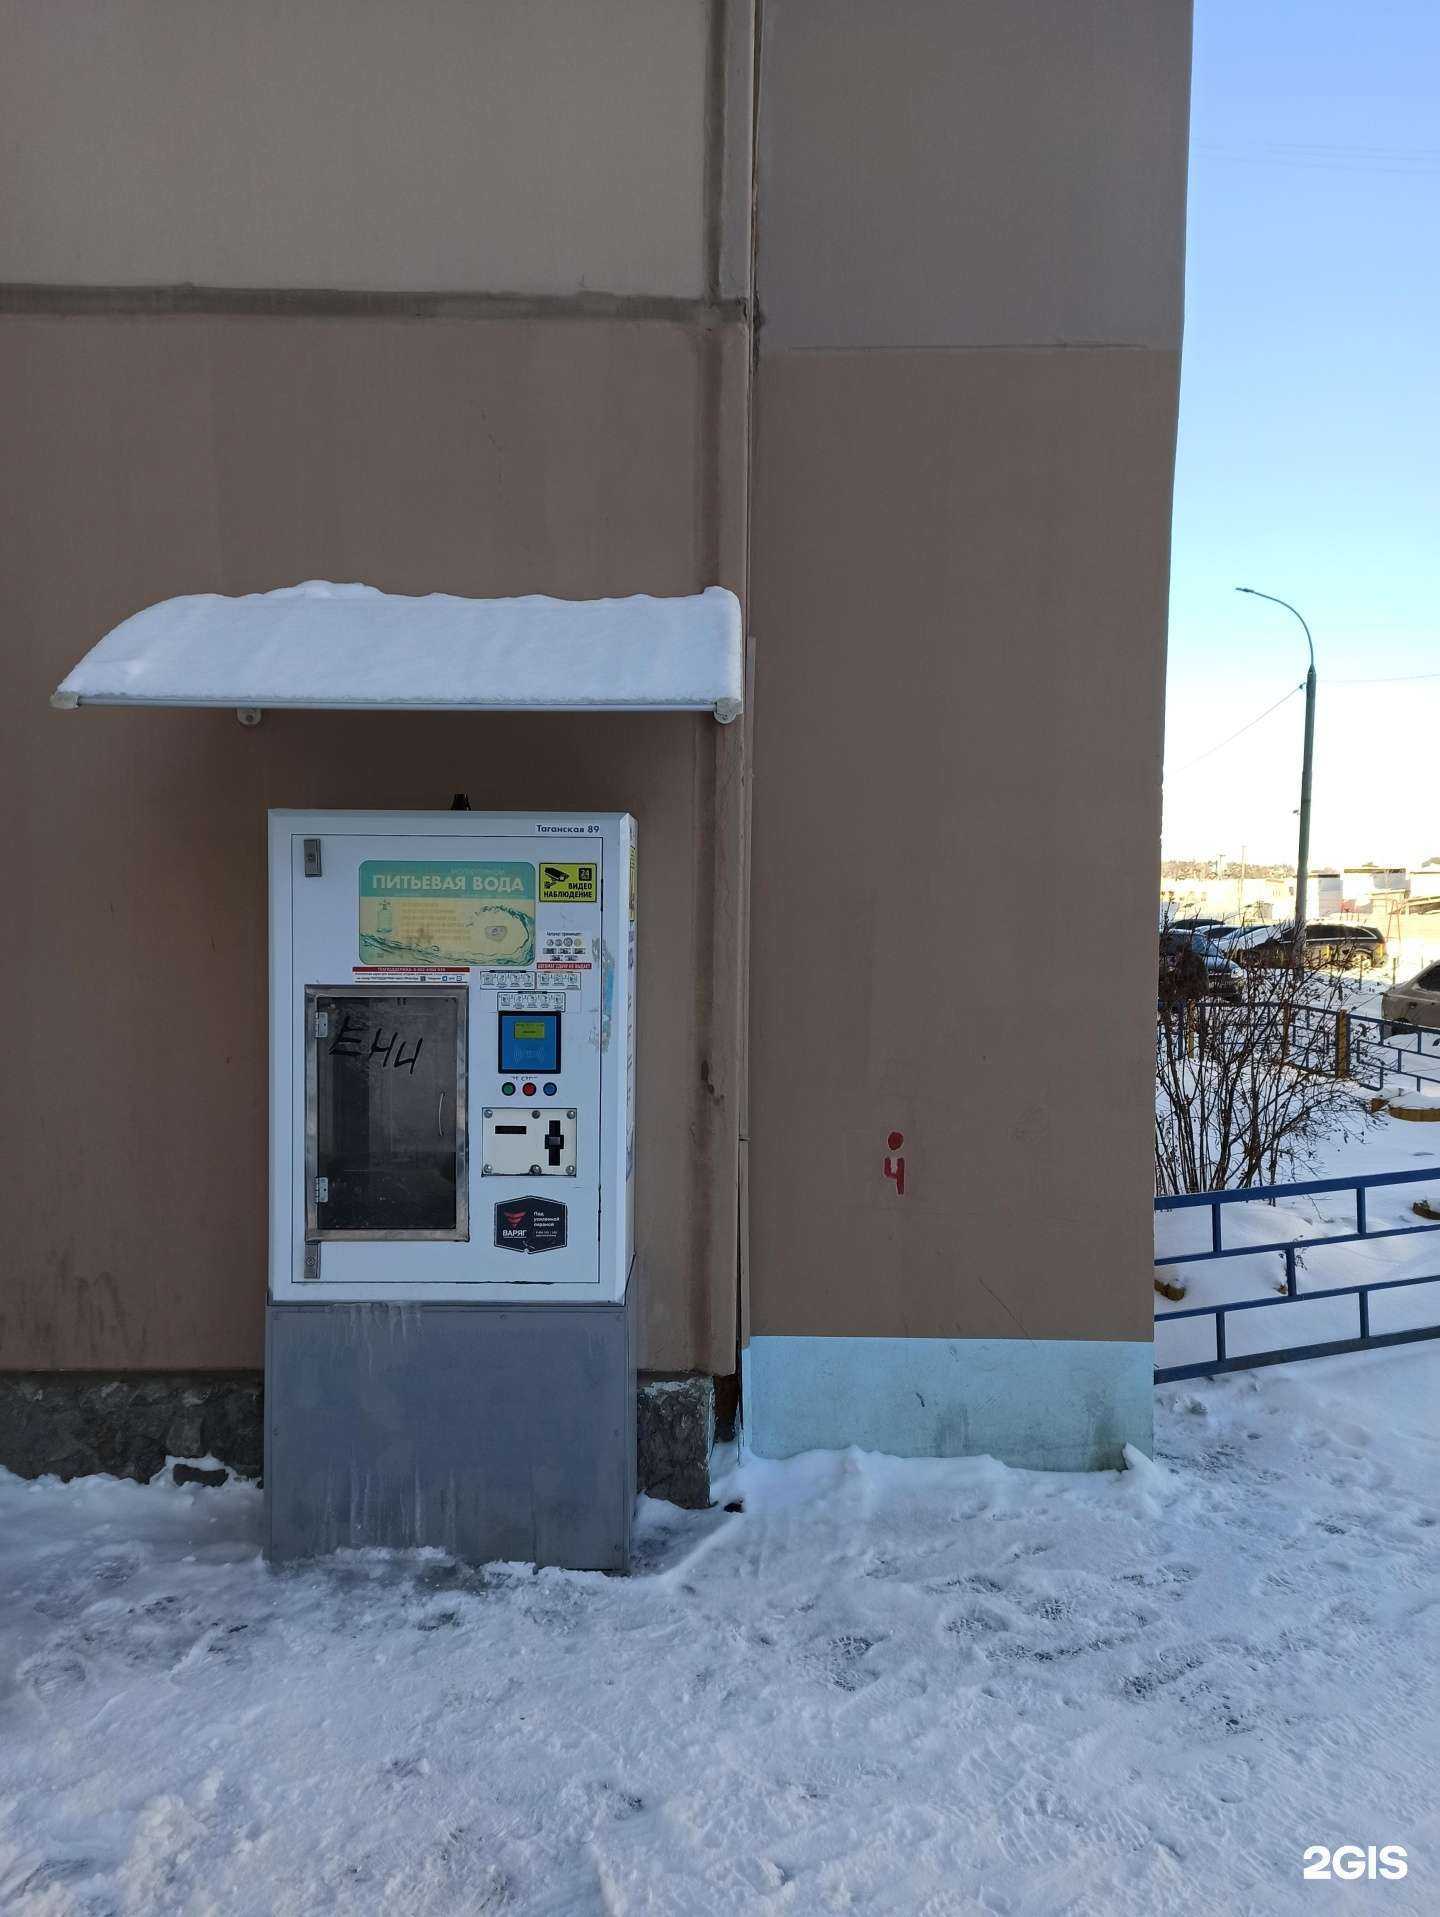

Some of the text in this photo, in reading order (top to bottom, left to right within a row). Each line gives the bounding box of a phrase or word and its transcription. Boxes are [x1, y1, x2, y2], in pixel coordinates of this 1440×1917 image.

[536, 824, 600, 833] Таганская 89
[372, 874, 525, 892] ПИТЬЕВАЯ ВОДА
[568, 882, 592, 891] ВИДЕО
[543, 890, 592, 899] НАБЛЮДЕНИЕ
[502, 1229, 527, 1237] ВАРЯГ
